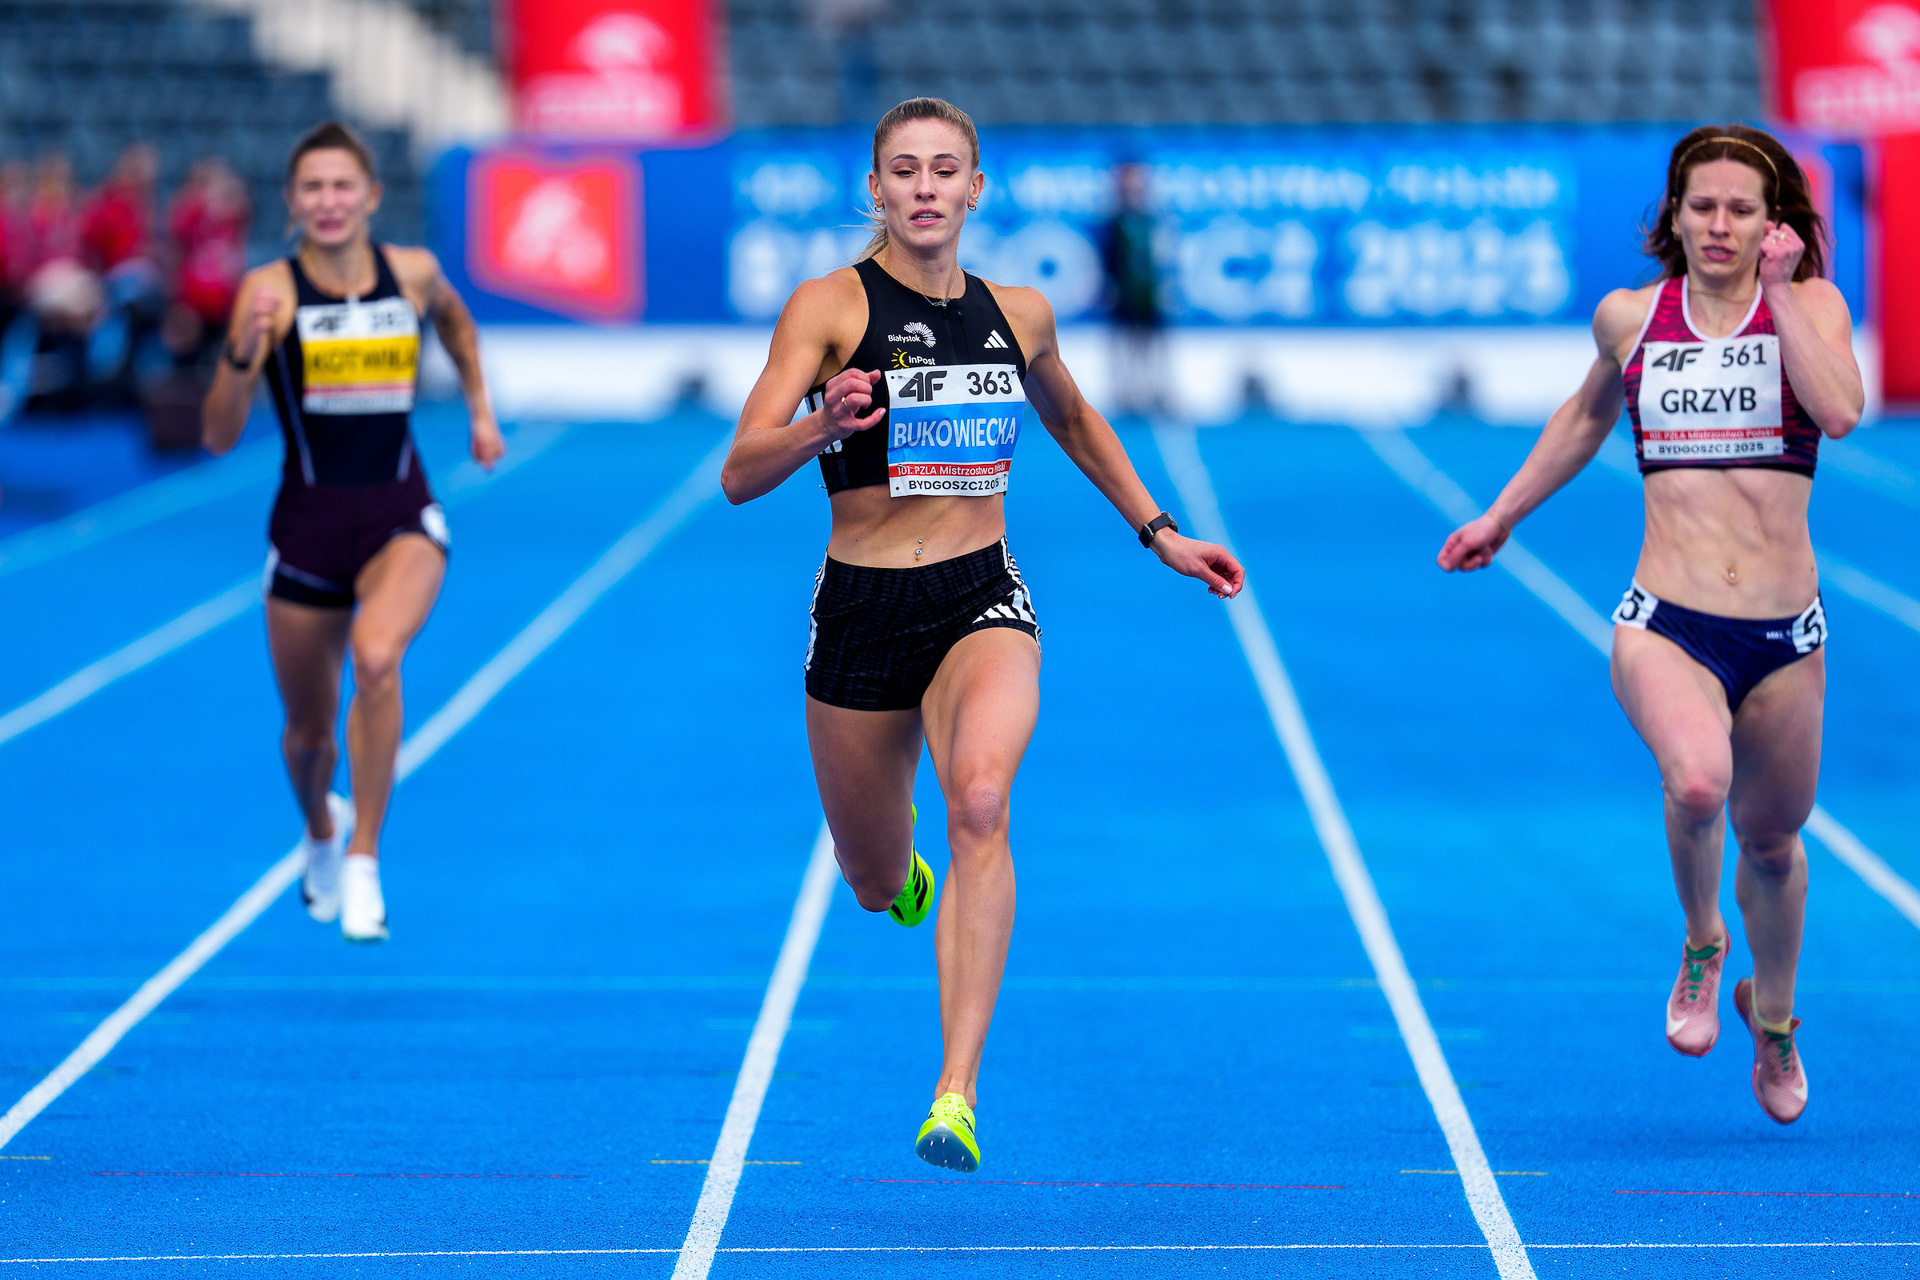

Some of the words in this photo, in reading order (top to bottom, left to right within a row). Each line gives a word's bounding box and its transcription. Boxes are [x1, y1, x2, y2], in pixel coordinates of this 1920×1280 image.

[908, 356, 936, 366] InPost
[1652, 347, 1704, 372] 4F
[1721, 343, 1768, 368] 561
[898, 371, 948, 402] 4F
[966, 370, 1013, 396] 363
[1660, 387, 1757, 413] GRZYB
[893, 417, 1016, 449] BUKOWIECKA
[1664, 430, 1686, 440] PZLA
[1687, 429, 1744, 440] Mistrzostwa
[1745, 428, 1775, 438] Polski
[1658, 443, 1730, 455] BYDGOSZCZ
[897, 466, 913, 476] 101.
[914, 465, 937, 475] PZLA
[939, 465, 994, 476] Mistrzostwa
[994, 462, 1007, 474] Plski
[908, 480, 983, 491] BYDGOSZCZ
[984, 478, 1000, 490] 205
[1619, 588, 1646, 621] 5
[1803, 609, 1823, 650] 5
